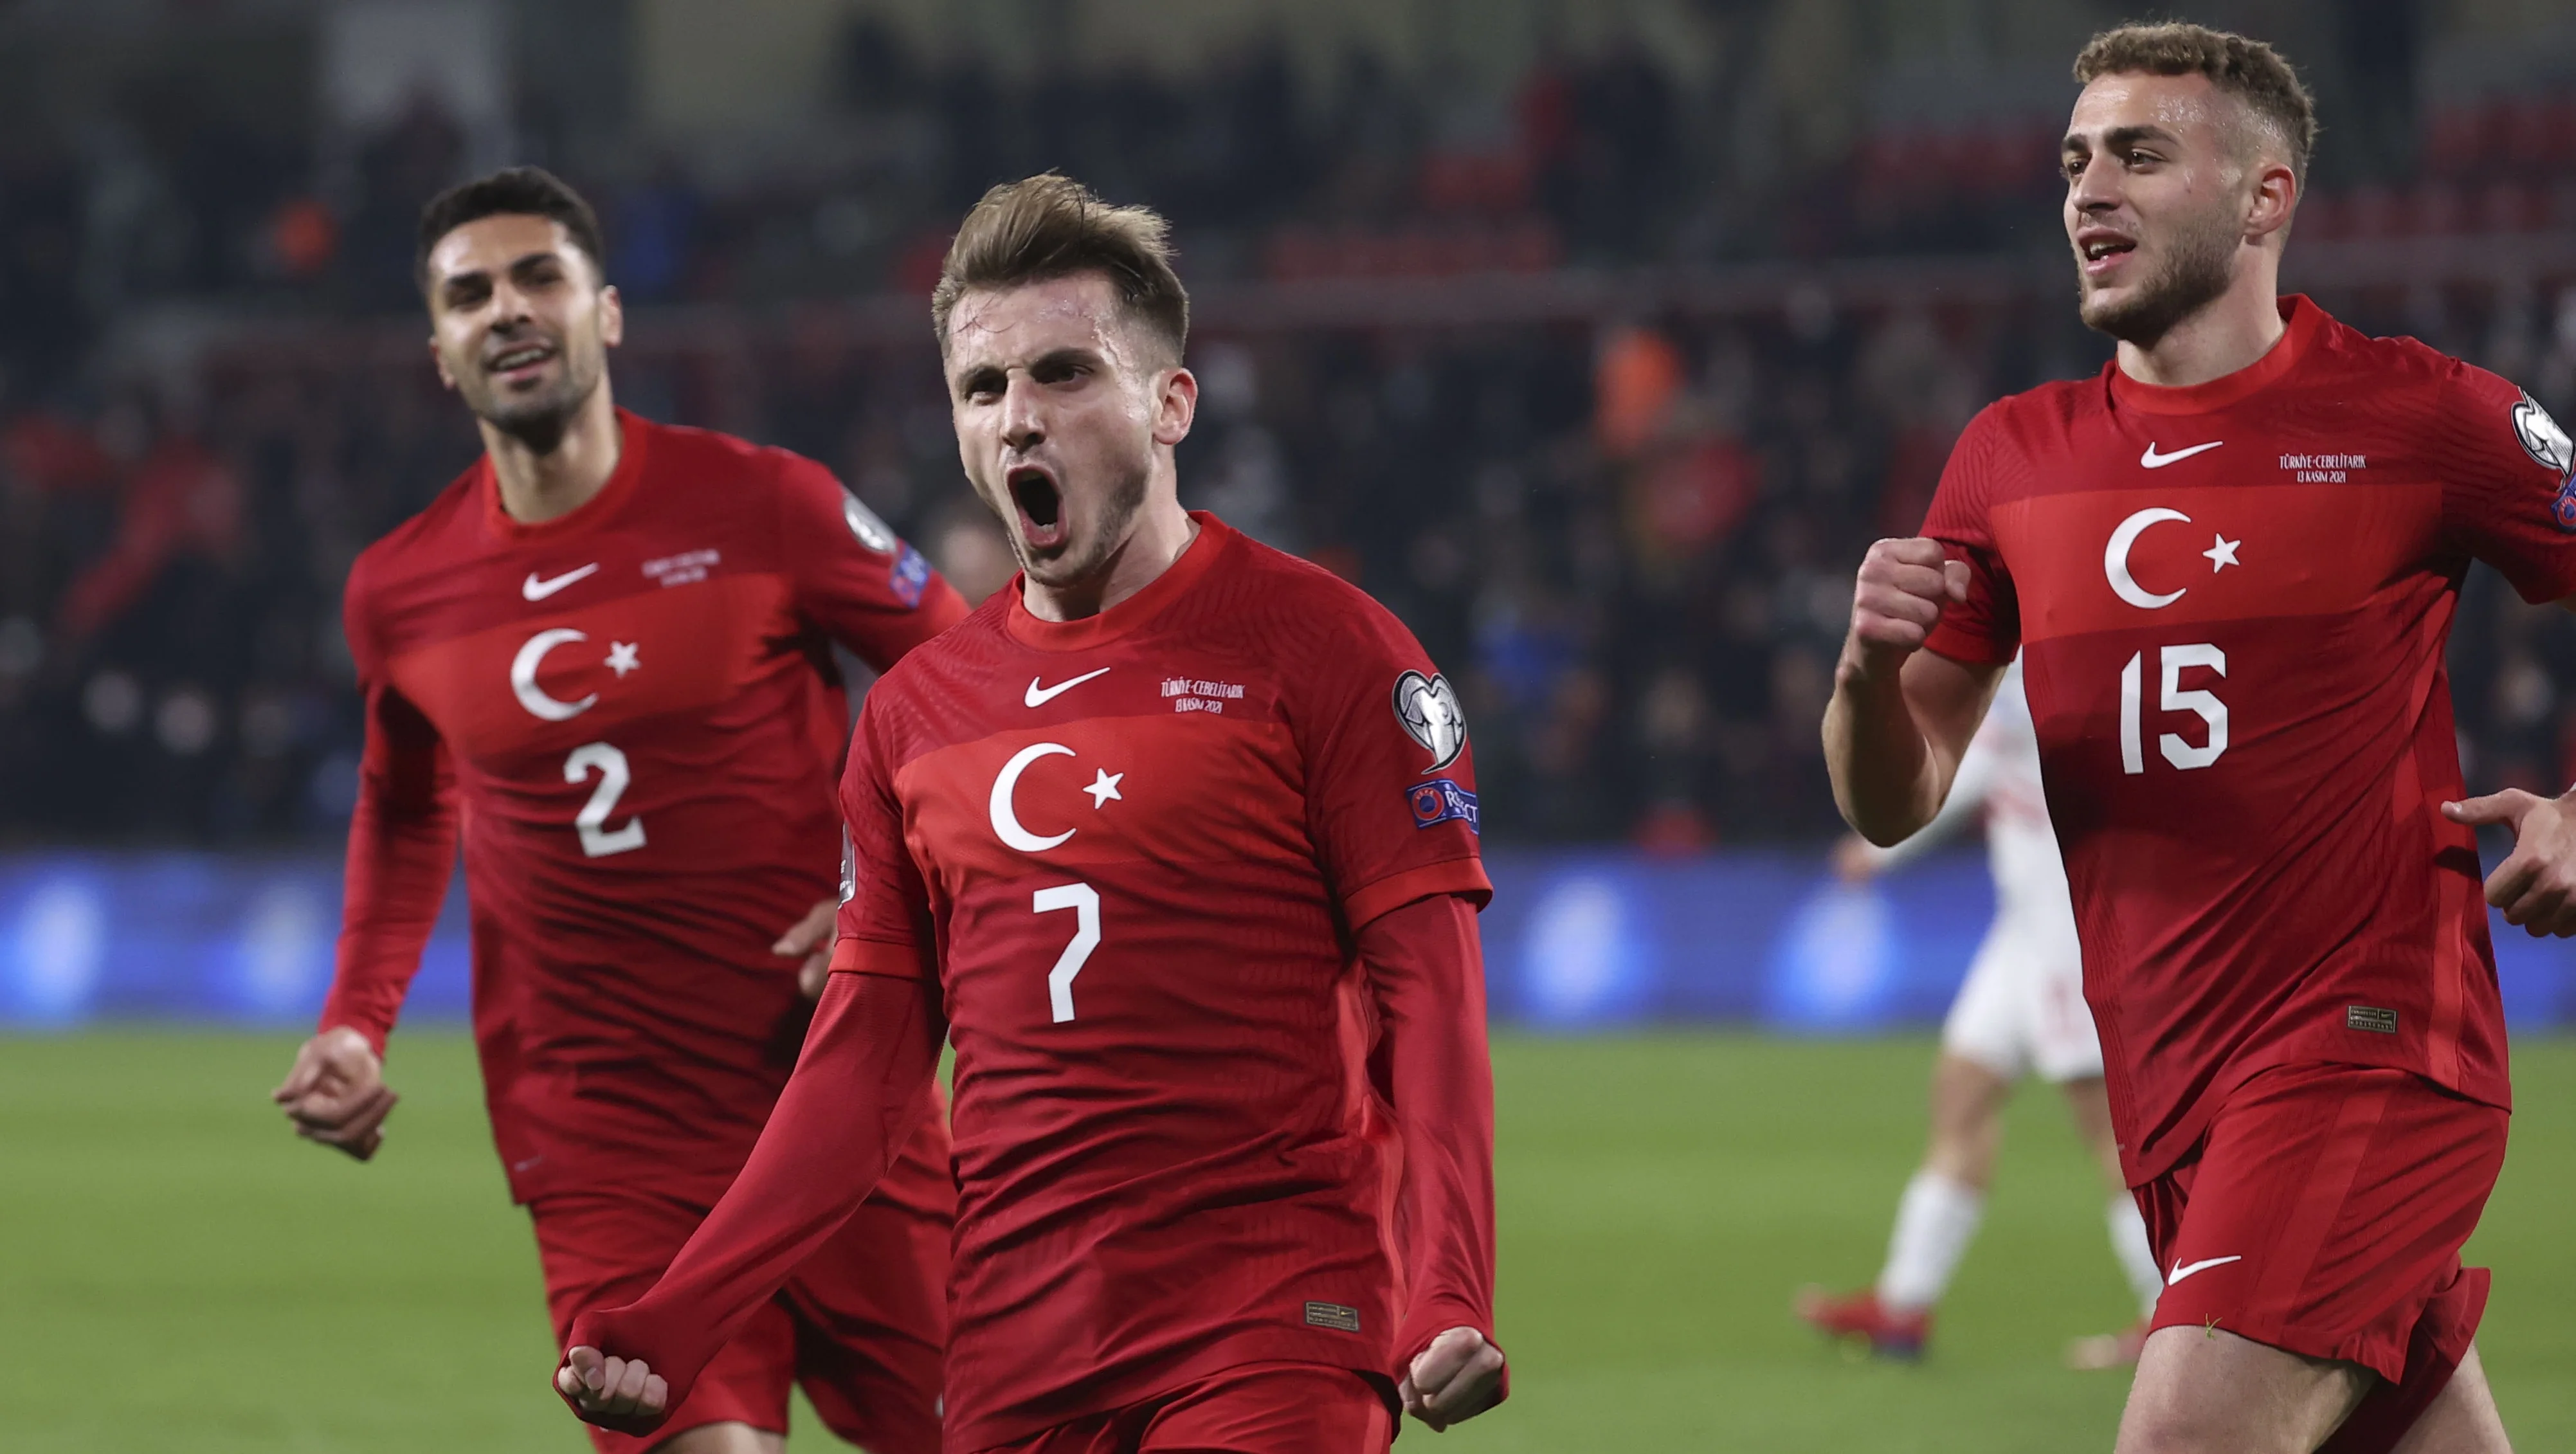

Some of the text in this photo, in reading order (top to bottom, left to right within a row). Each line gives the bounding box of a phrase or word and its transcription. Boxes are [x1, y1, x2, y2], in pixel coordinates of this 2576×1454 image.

[2297, 470, 2346, 483] 13 KASIM 2021
[2120, 643, 2228, 774] 15
[563, 742, 647, 858] 2
[1033, 882, 1102, 1024] 7
